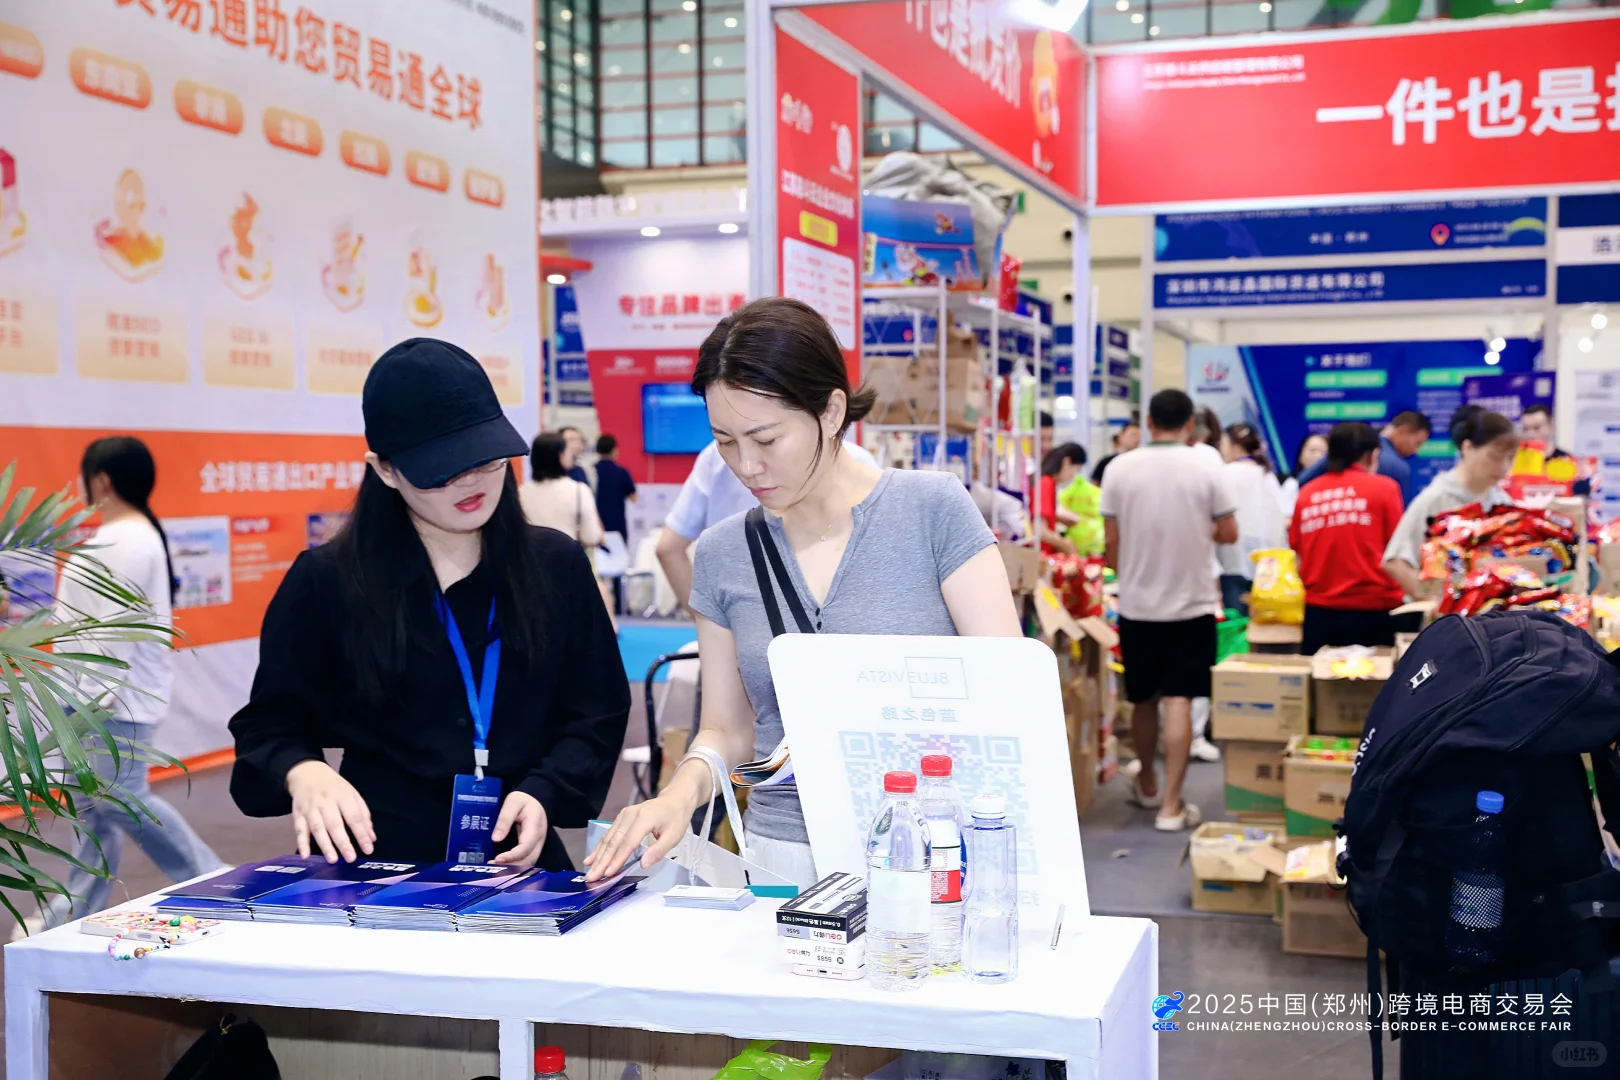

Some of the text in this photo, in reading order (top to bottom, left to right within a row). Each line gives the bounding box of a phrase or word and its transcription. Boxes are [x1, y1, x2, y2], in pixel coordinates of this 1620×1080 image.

[1316, 66, 1620, 145] 一件也是
[460, 814, 490, 831] 参展证
